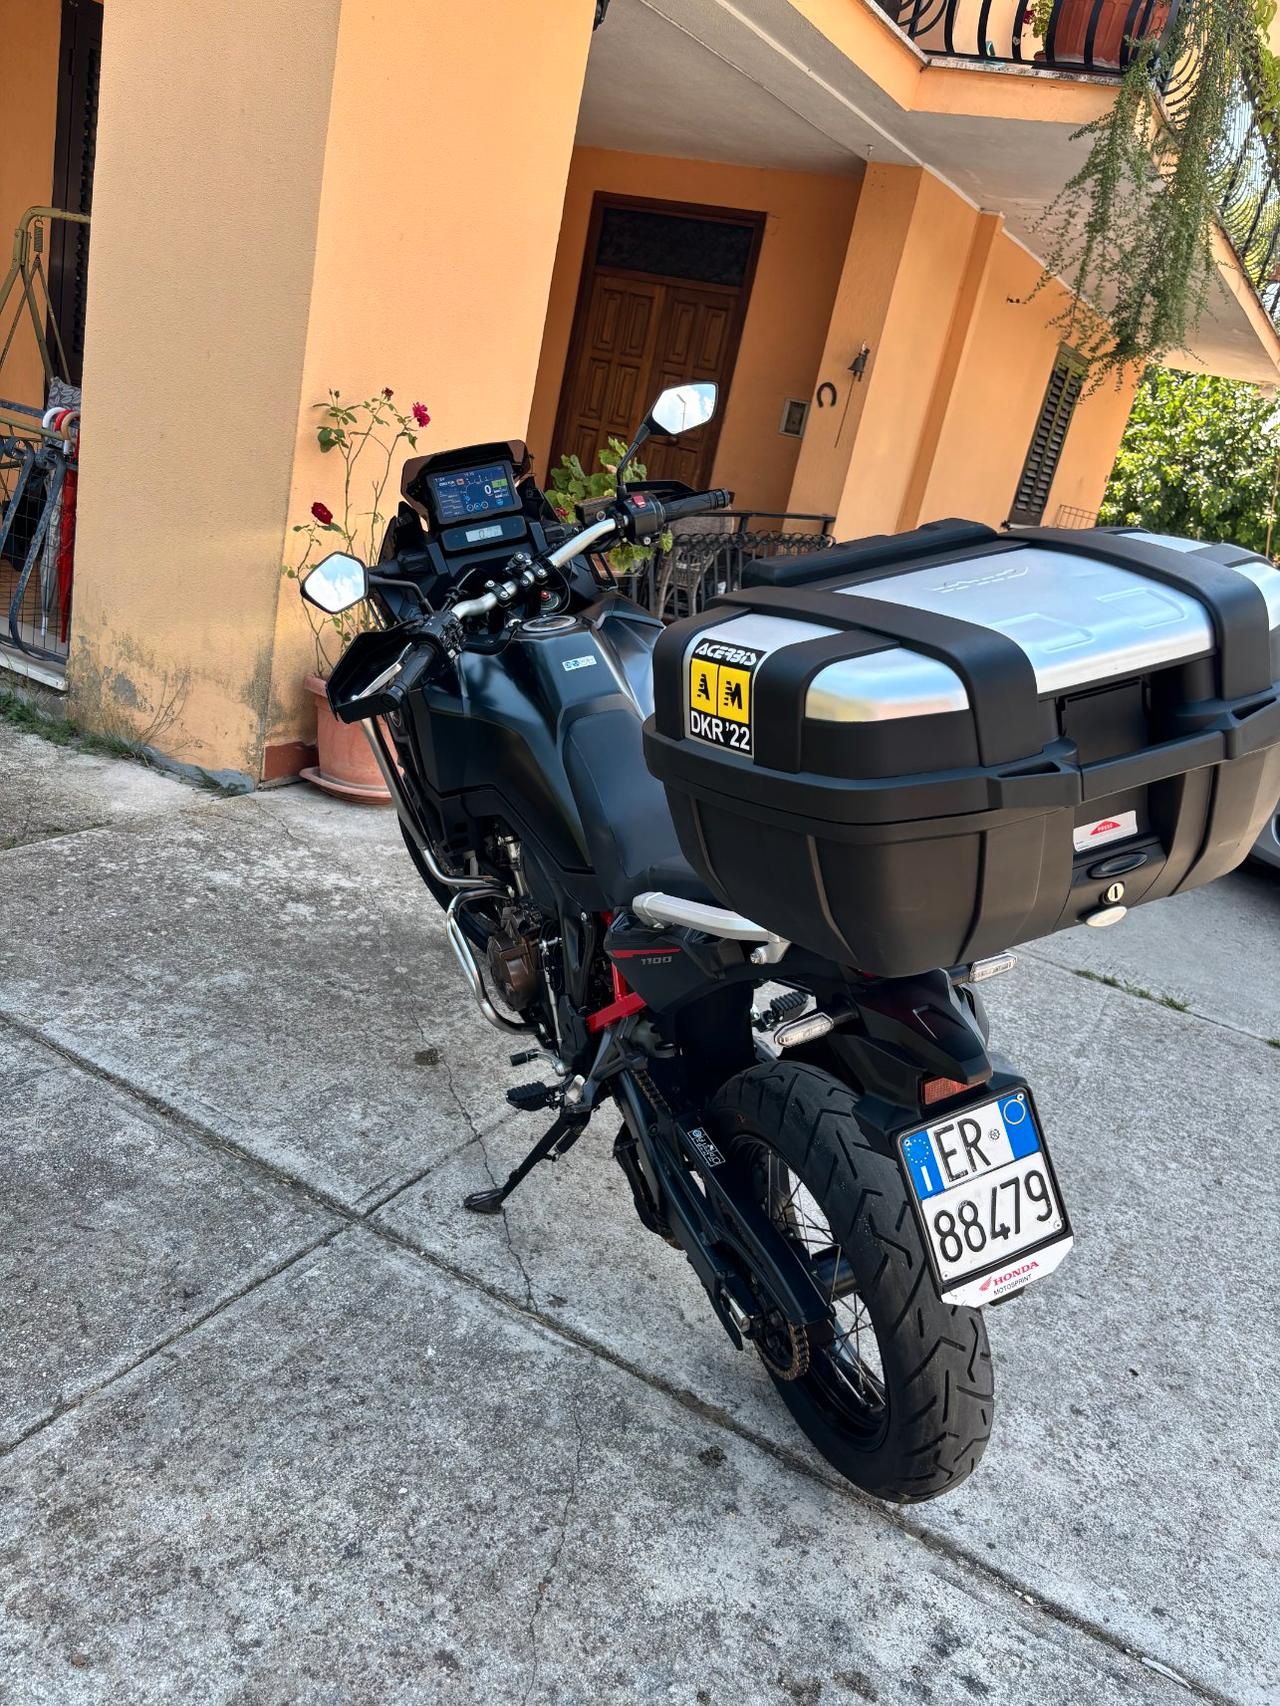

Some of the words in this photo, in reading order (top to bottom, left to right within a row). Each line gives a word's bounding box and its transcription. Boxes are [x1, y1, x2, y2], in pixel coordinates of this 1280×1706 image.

[695, 643, 757, 666] ACERBIS
[691, 710, 724, 743] DKR
[640, 956, 673, 965] 1100
[933, 1118, 992, 1182] ER
[920, 1165, 933, 1192] I
[933, 1169, 1053, 1263] 88479
[993, 1259, 1039, 1287] HONDA
[993, 1273, 1032, 1296] MOTOSPRINT
